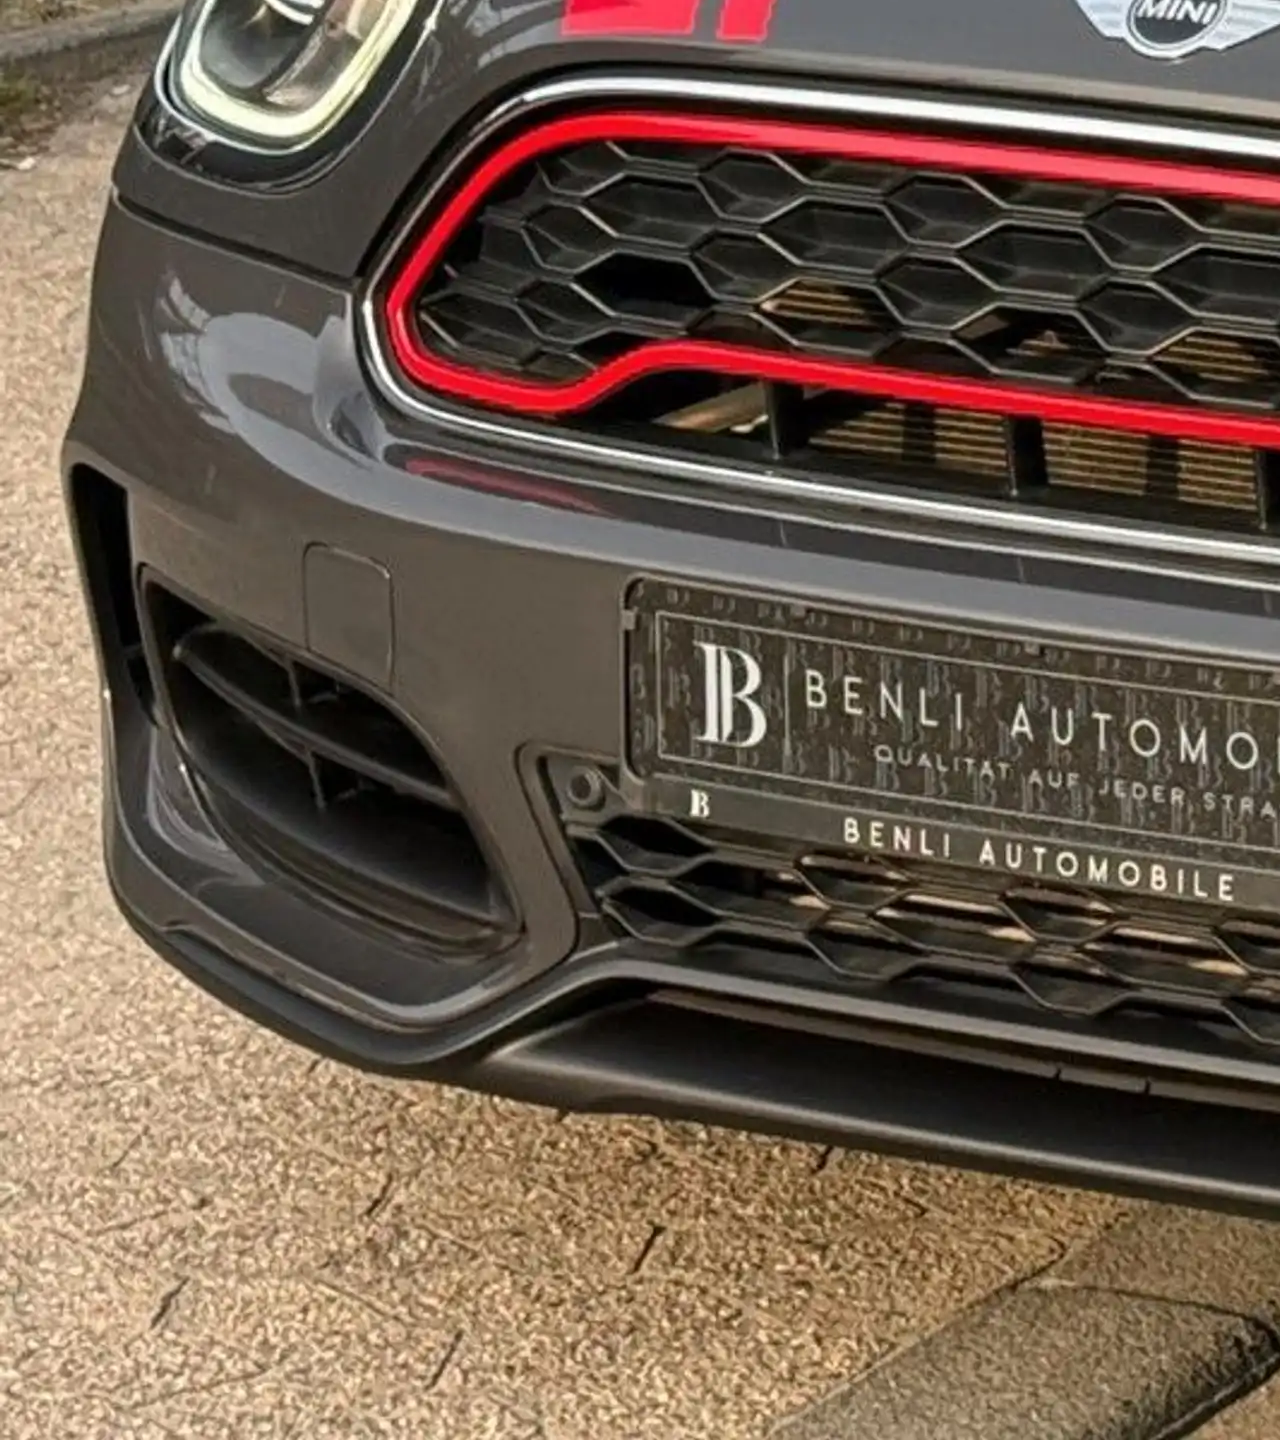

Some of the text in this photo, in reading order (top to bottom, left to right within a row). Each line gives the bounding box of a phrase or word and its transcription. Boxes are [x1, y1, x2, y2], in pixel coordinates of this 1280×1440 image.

[804, 667, 965, 732] BENLI
[1029, 767, 1081, 789] AUF
[1099, 779, 1187, 807] JEDER
[843, 816, 951, 857] BENLI
[978, 839, 1236, 902] AUTOMOBILE
